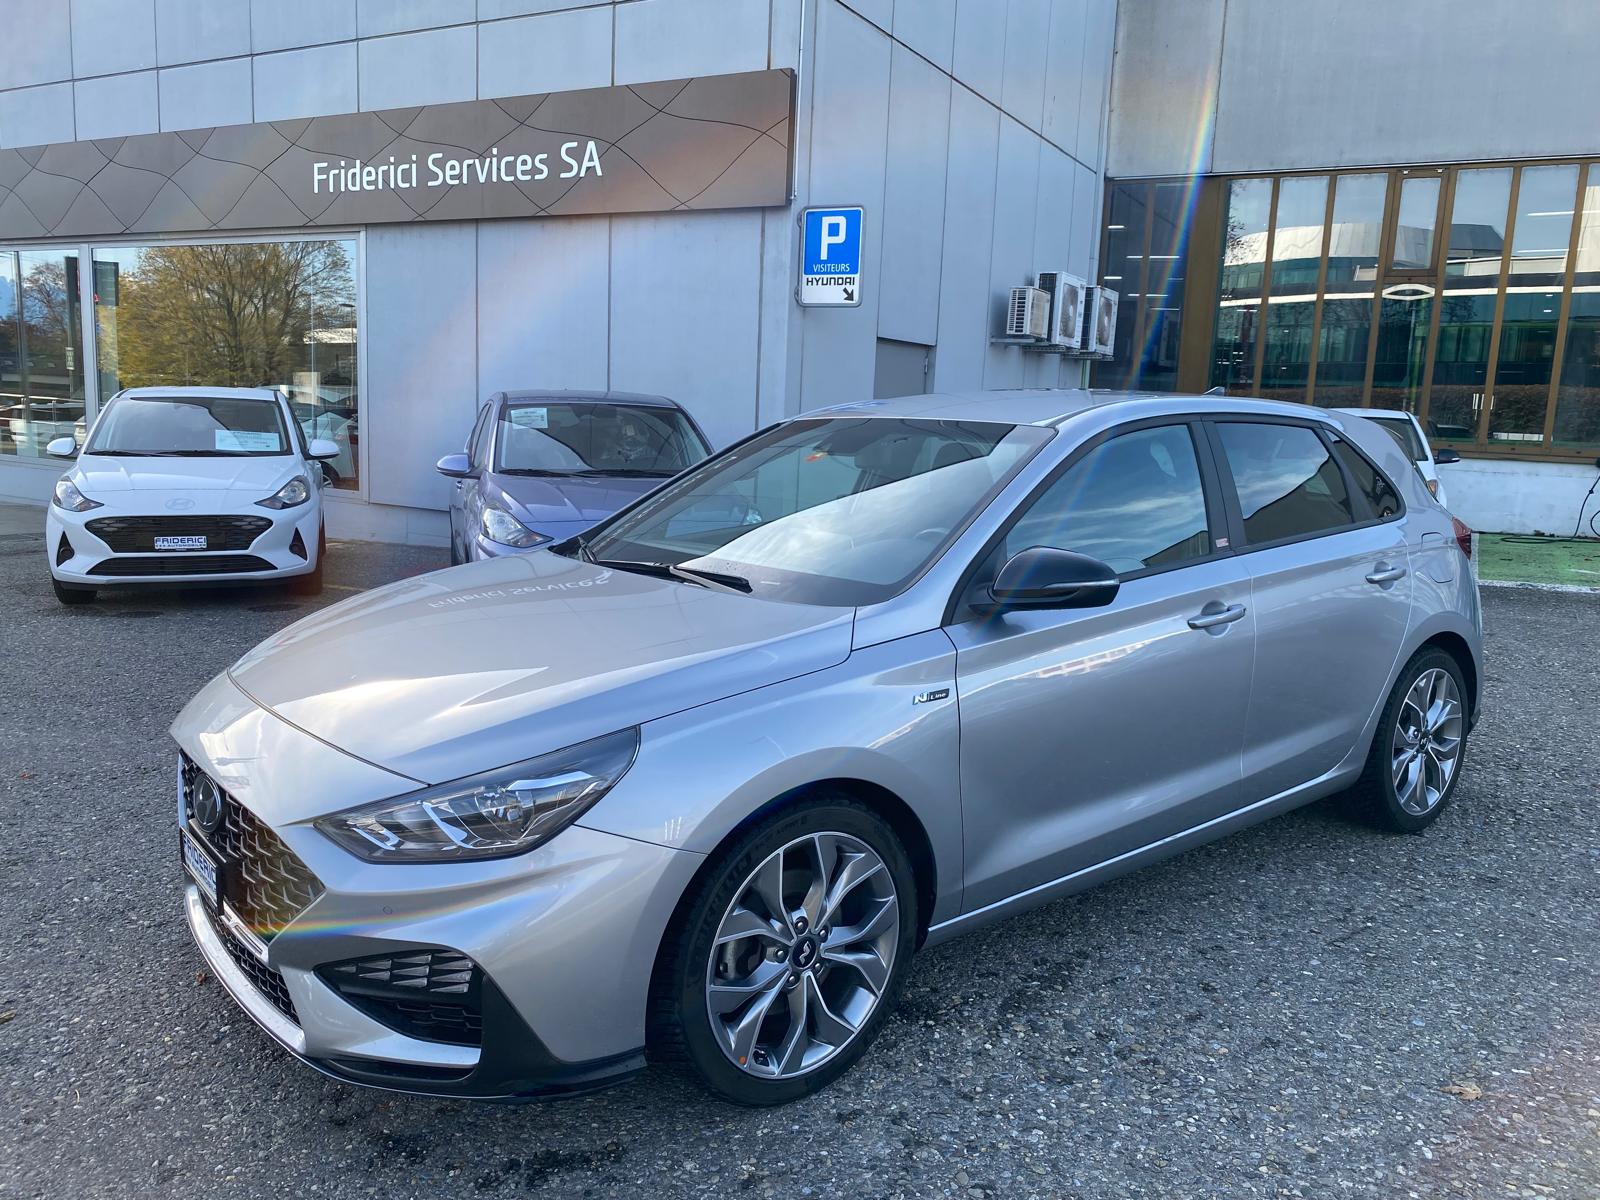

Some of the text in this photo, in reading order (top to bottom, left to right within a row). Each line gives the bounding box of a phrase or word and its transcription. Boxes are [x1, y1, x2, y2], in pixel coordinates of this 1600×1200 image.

[312, 140, 603, 194] Friderici Services SA
[820, 216, 847, 261] P
[806, 277, 856, 286] HYUNDAI
[812, 263, 850, 272] VISITEURS
[183, 833, 217, 884] FRIDERIC
